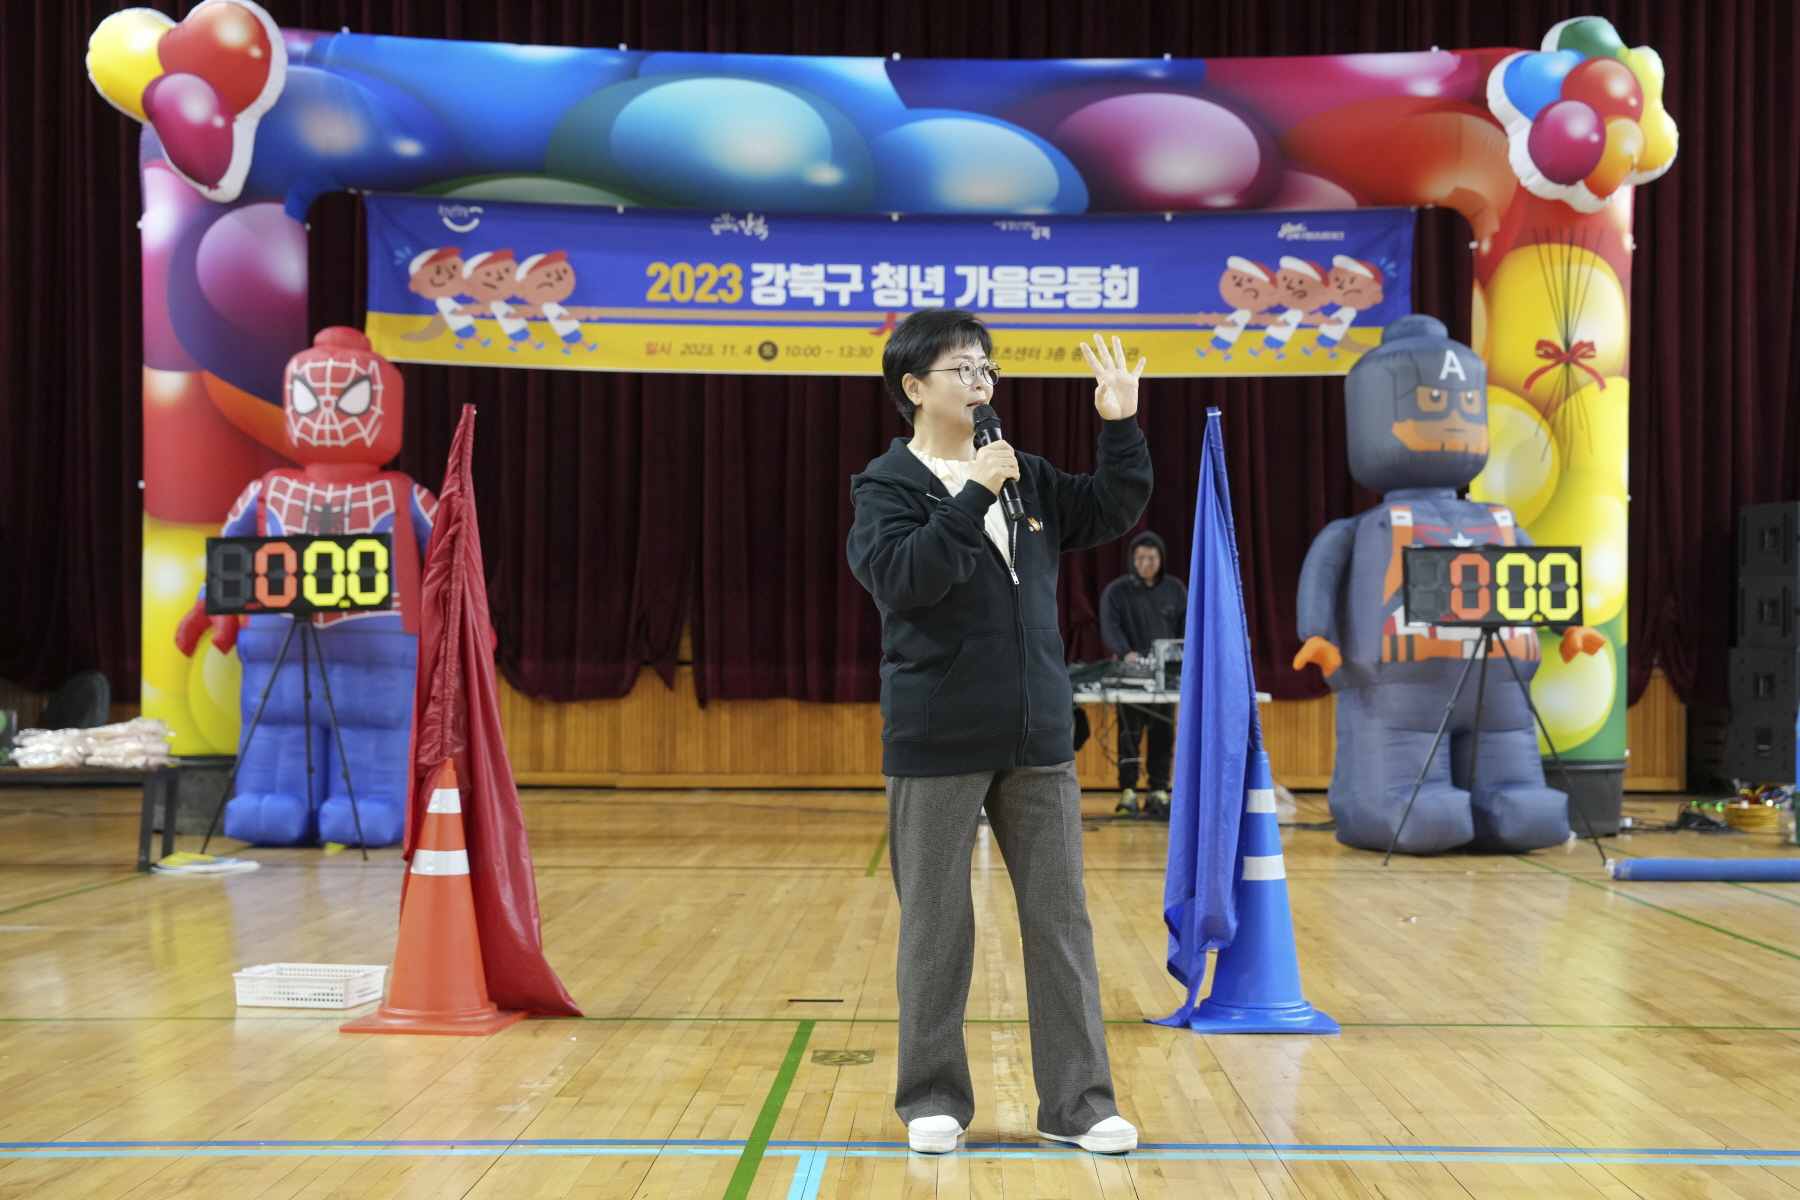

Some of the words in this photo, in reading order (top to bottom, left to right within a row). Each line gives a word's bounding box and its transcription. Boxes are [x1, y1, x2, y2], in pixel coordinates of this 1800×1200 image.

[646, 261, 743, 304] 2023
[750, 262, 864, 306] 강북구
[871, 261, 946, 307] 청년
[954, 264, 1139, 309] 가을운동회
[645, 342, 673, 356] 일시
[743, 345, 753, 356] 4
[785, 345, 821, 358] 10:00
[839, 345, 874, 358] 13:30
[1439, 349, 1466, 382] A
